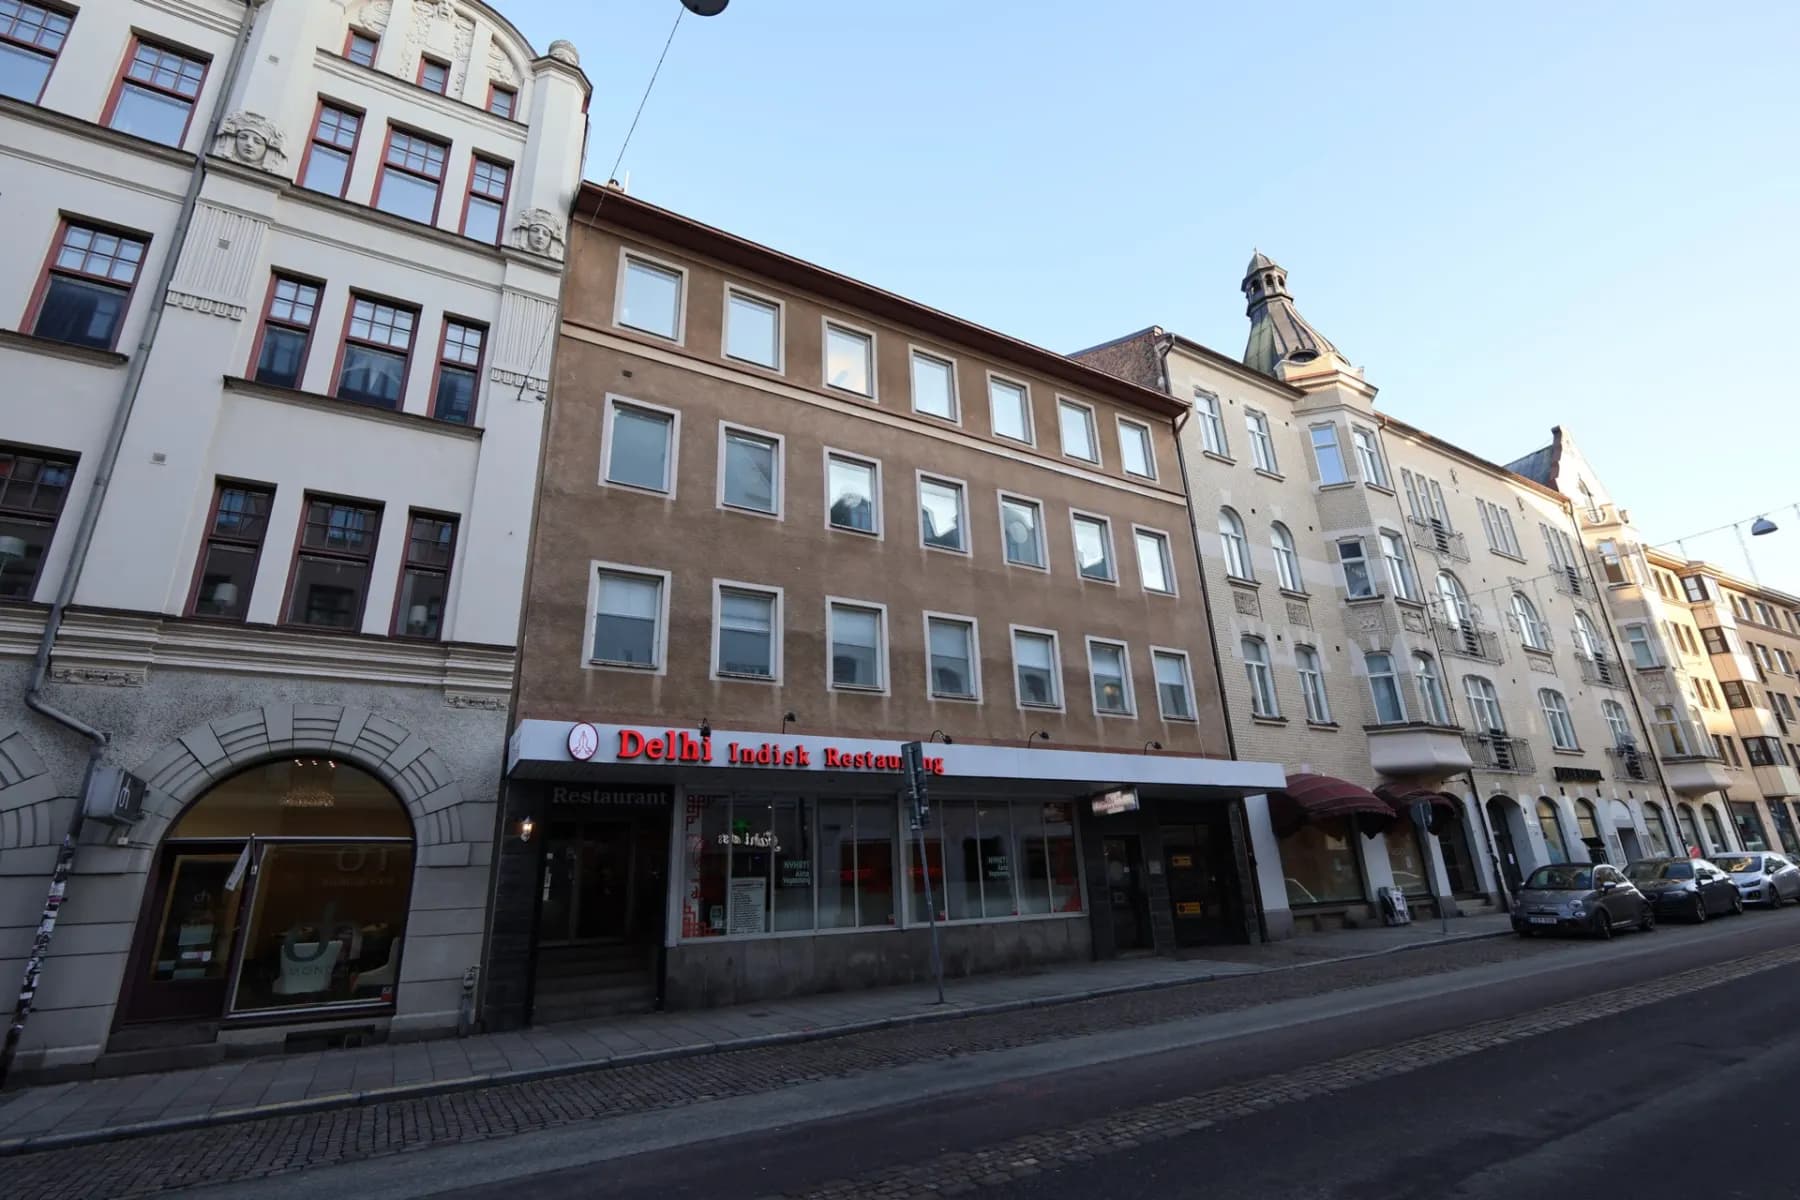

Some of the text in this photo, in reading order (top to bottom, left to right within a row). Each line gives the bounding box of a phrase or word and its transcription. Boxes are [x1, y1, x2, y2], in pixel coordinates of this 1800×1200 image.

[617, 729, 945, 775] Delhi Indisk Restaung
[551, 785, 669, 806] Restaurant
